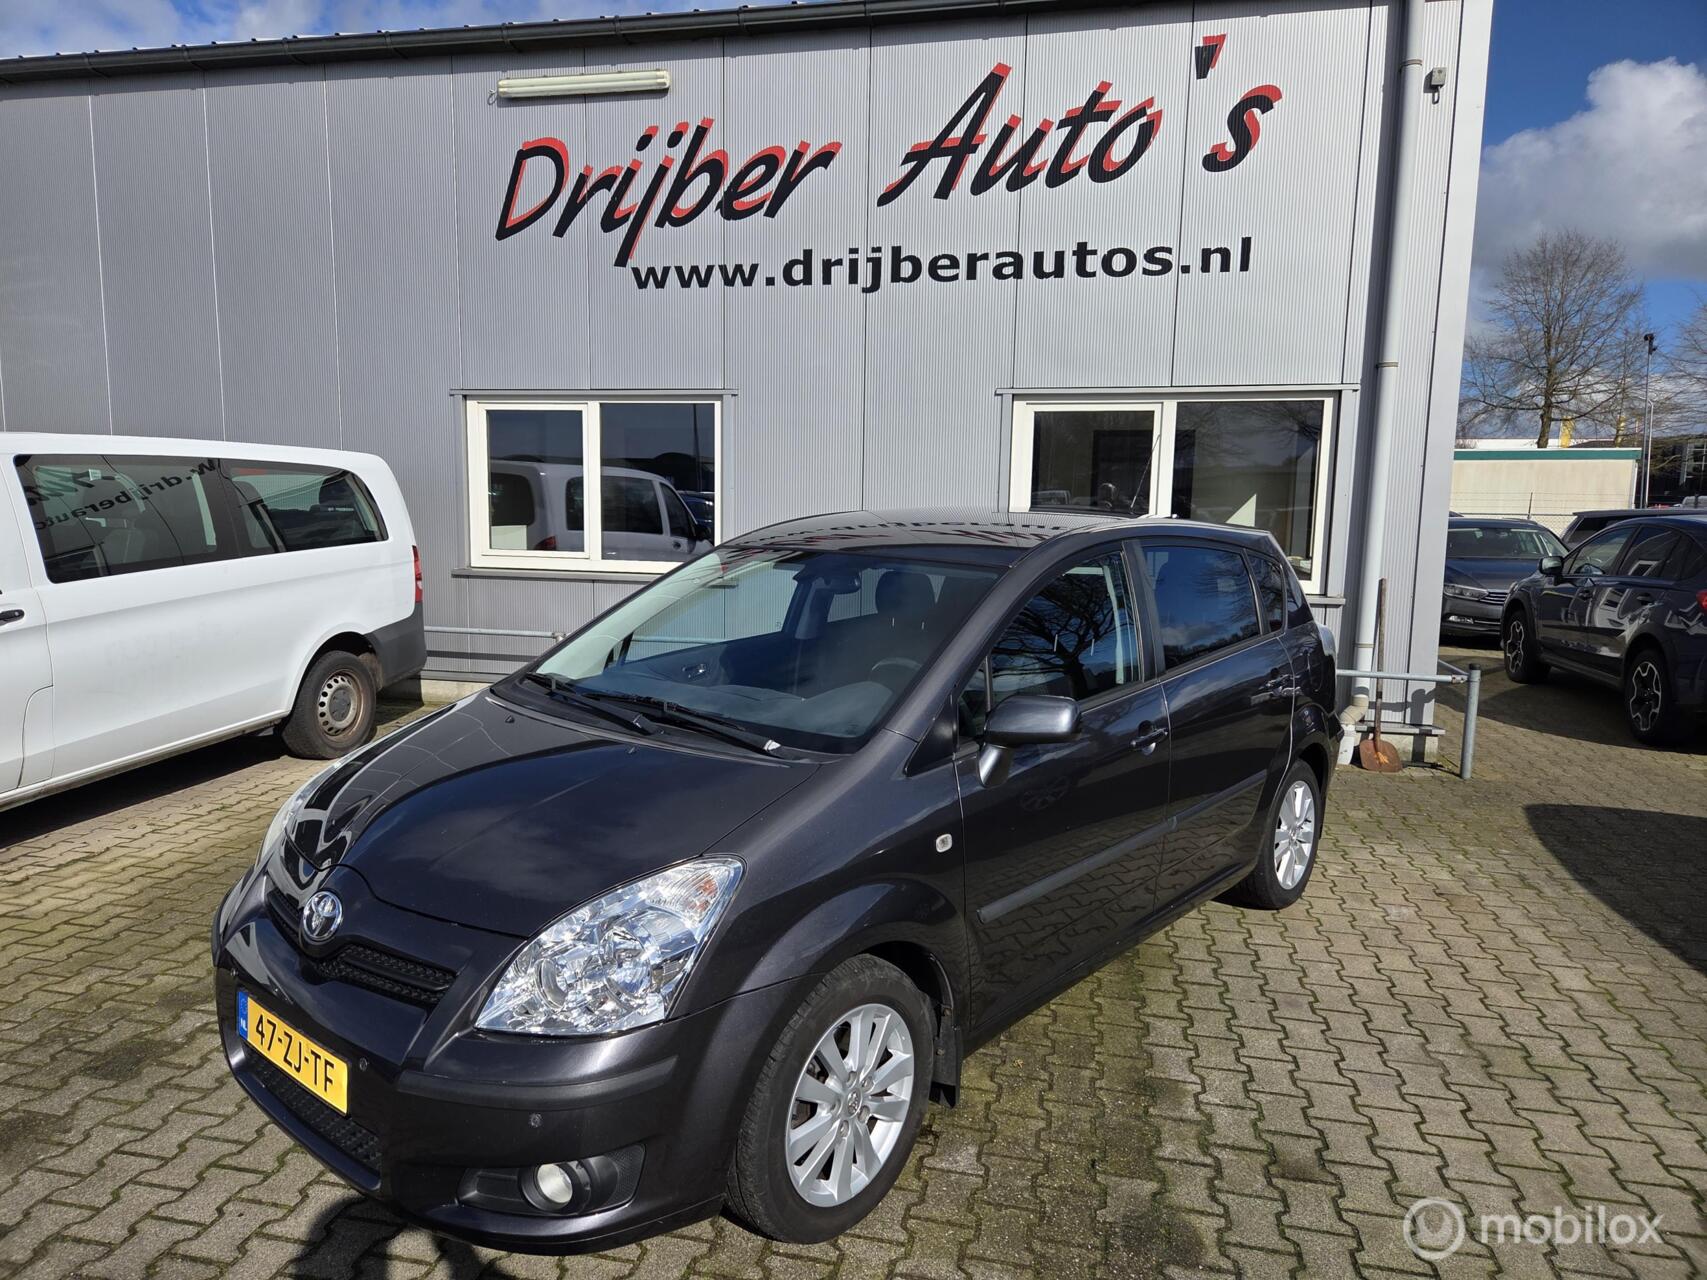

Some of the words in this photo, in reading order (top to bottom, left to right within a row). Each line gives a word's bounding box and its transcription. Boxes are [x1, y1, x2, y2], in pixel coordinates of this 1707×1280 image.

[495, 117, 842, 267] Drijber
[877, 34, 1282, 207] Auto's
[631, 237, 1252, 293] www.drijberautos.nl
[256, 1014, 334, 1092] 47-ZJ-TF
